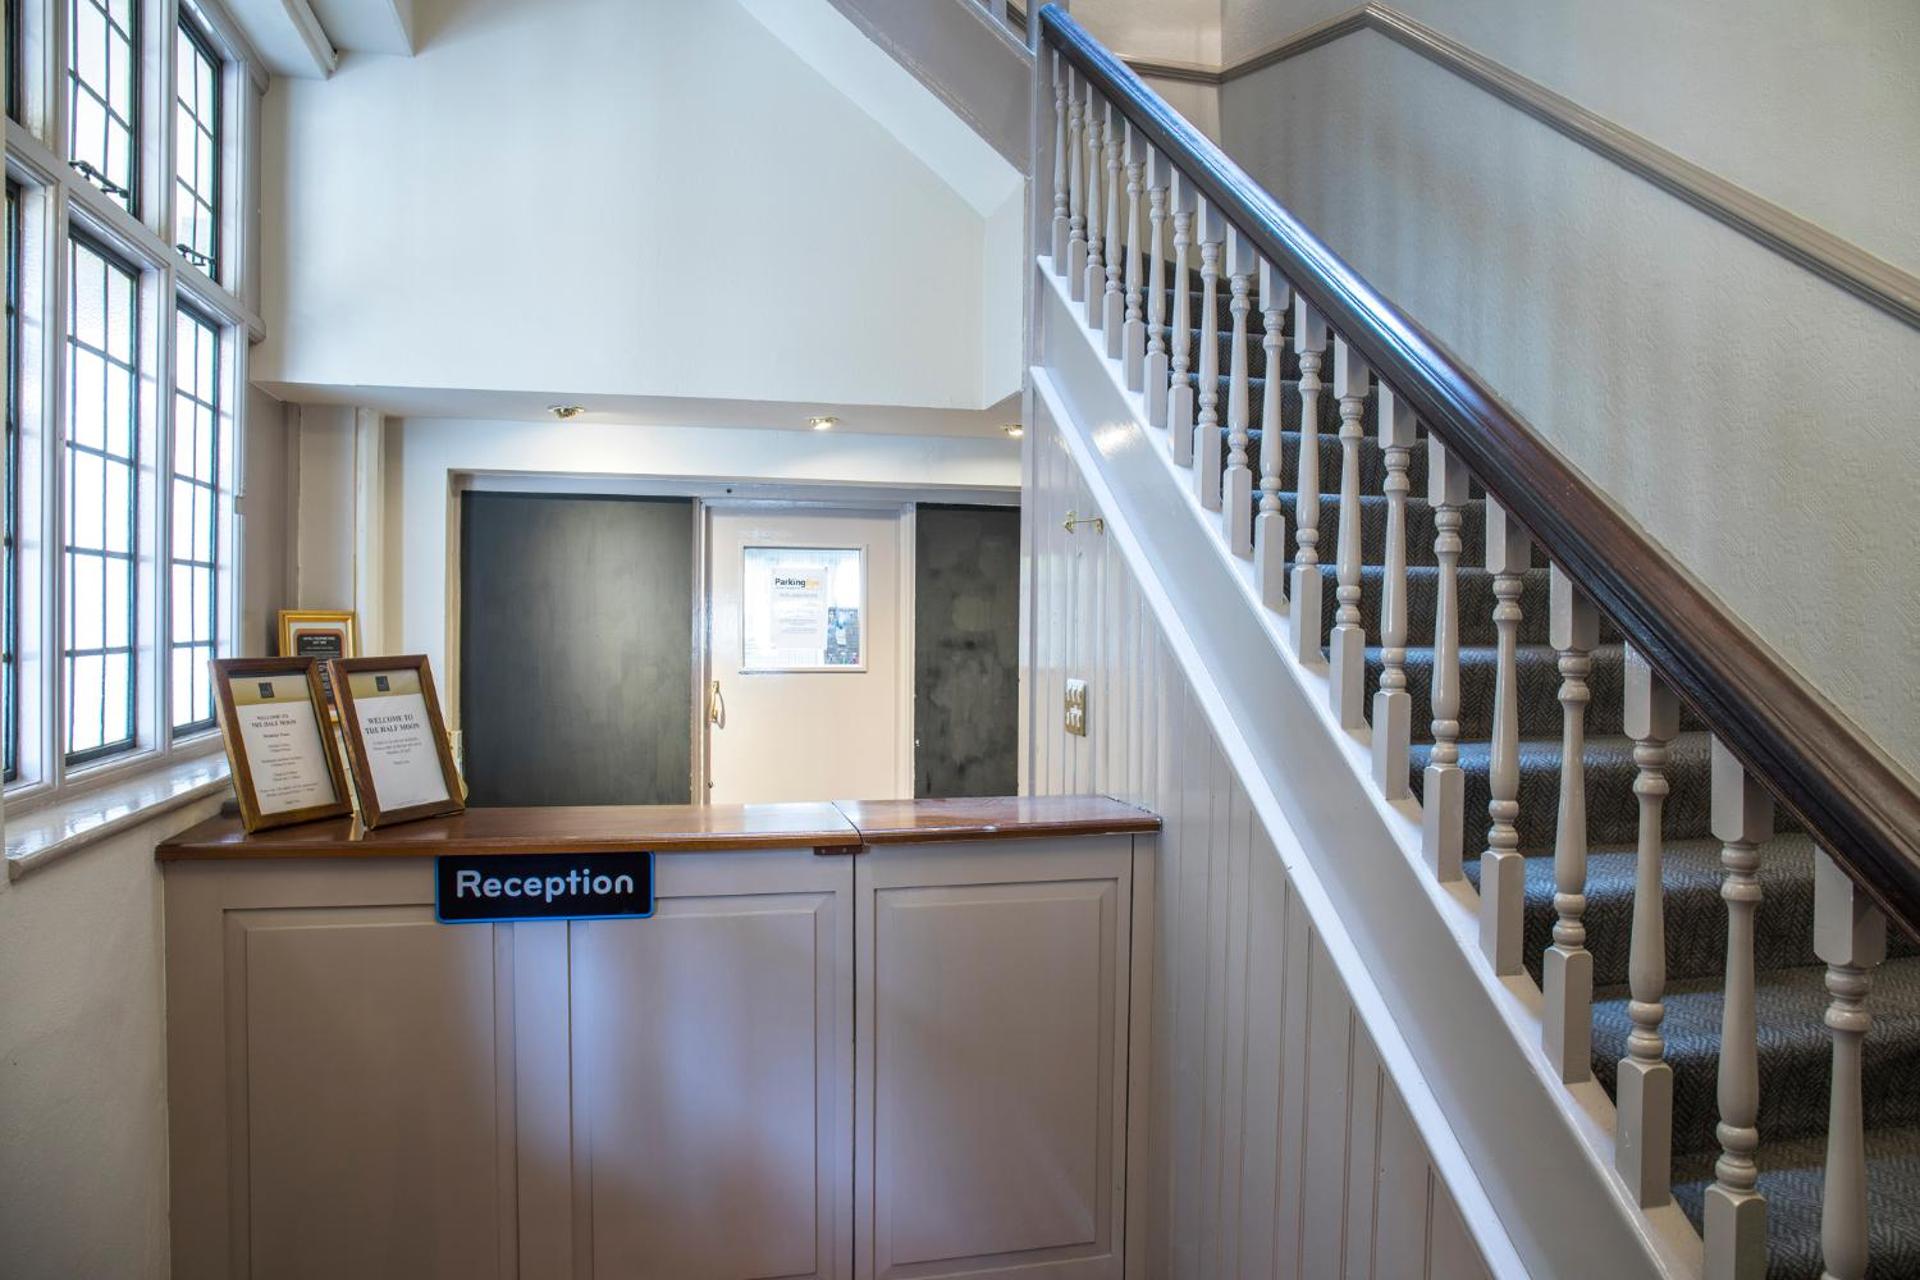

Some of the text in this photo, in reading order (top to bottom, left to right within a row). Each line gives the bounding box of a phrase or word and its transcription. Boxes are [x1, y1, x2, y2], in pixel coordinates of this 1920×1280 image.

[775, 577, 806, 588] Parking
[368, 713, 413, 724] WELCOME TO
[365, 722, 420, 734] THE HALF MOON
[457, 869, 633, 903] Reception
